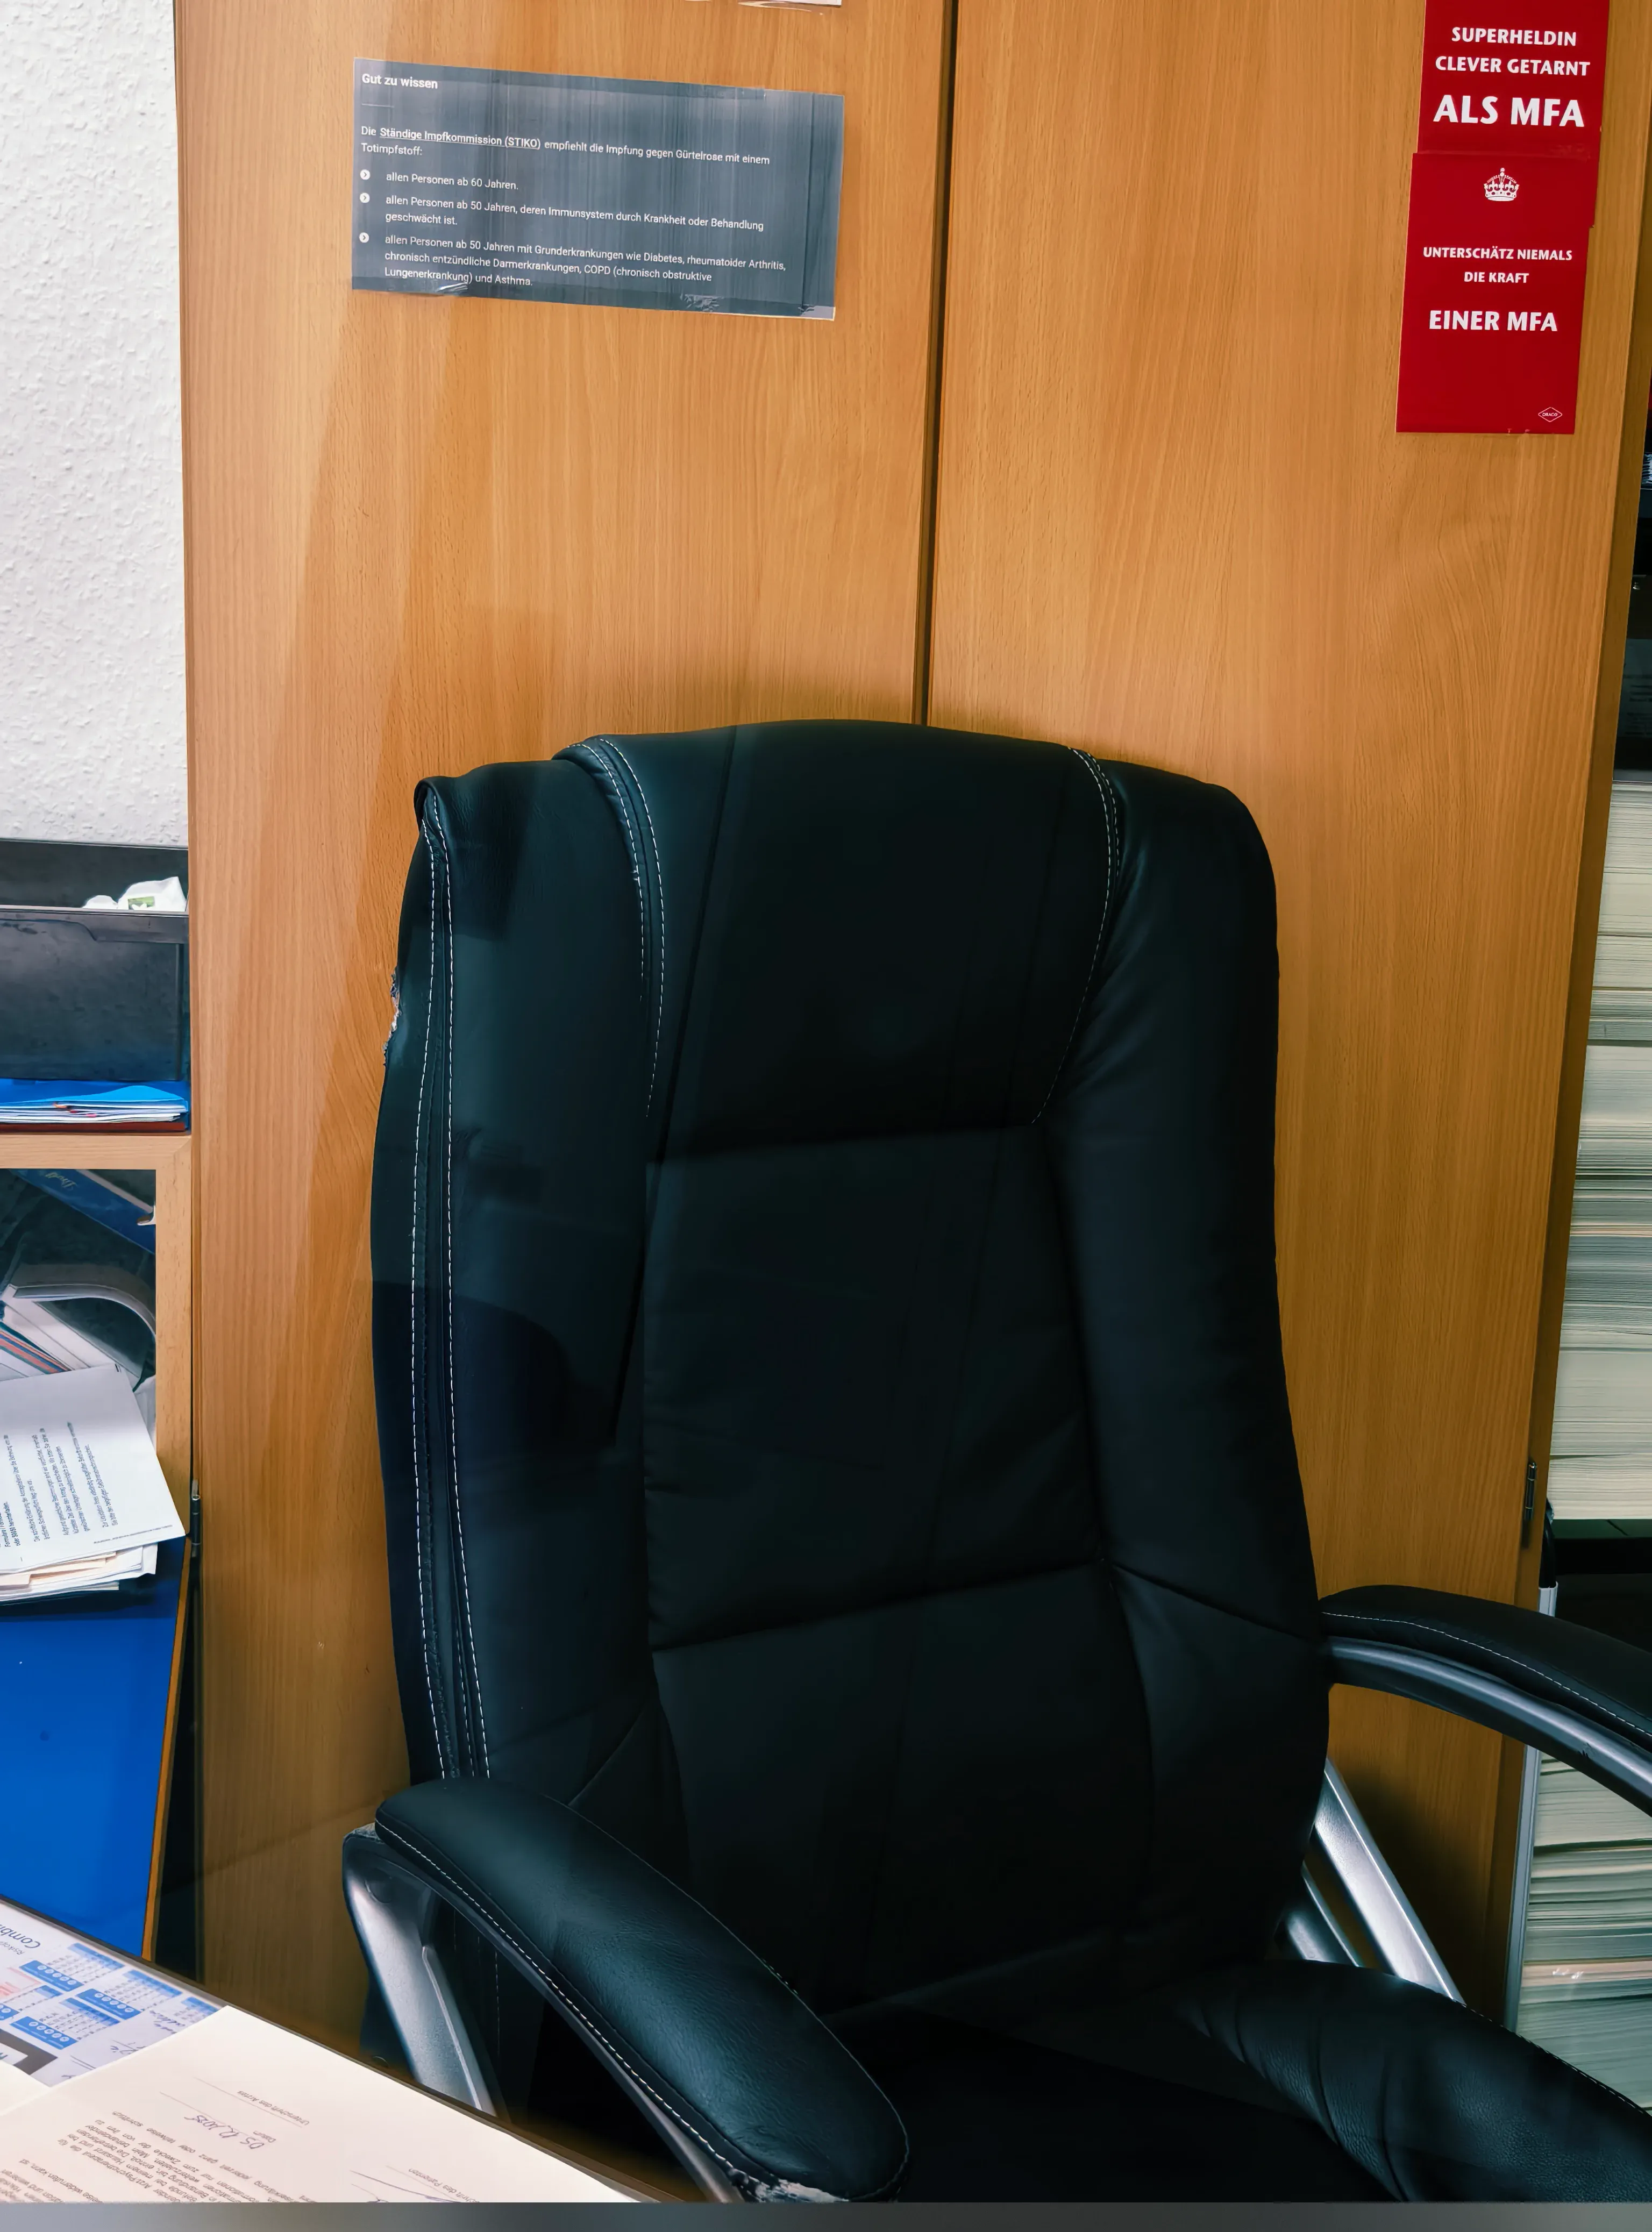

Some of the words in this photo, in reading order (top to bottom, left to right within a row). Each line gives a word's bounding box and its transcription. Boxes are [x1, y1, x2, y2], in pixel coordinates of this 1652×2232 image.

[1451, 26, 1576, 46] SUPERHELDIN
[1435, 55, 1502, 73] CLEVER
[1507, 59, 1591, 76] GETARNT
[362, 73, 381, 84] Gut
[384, 76, 397, 86] zu
[400, 77, 438, 89] wissen
[1433, 95, 1498, 124] ALS
[1511, 97, 1584, 127] MFA
[361, 126, 376, 136] Die
[380, 127, 422, 140] Ständige
[424, 131, 502, 146] Impfkommission
[504, 136, 541, 149] (STIKO)
[544, 141, 587, 153] empfiehlt
[589, 143, 604, 153] die
[606, 145, 644, 158] Impfung
[646, 148, 673, 159] gegen
[675, 149, 723, 161] Gürtelrose
[725, 154, 740, 162] mit
[742, 154, 770, 165] einem
[361, 142, 423, 156] Totimpfstoff:
[386, 173, 409, 182] allen
[411, 174, 454, 185] Personen
[457, 177, 468, 186] ab
[471, 178, 482, 187] 60
[485, 179, 519, 190] Jahren.
[386, 196, 409, 205] allen
[411, 197, 454, 209] Personen
[457, 200, 468, 209] ab
[471, 201, 482, 210] 50
[485, 203, 518, 215] Jahren,
[520, 205, 546, 216] deren
[548, 207, 614, 220] Immunsystem
[616, 212, 642, 222] durch
[644, 213, 686, 225] Krankheit
[688, 216, 709, 226] oder
[711, 218, 764, 232] Behandlung
[386, 213, 442, 225] geschwächt
[443, 216, 458, 225] ist.
[385, 236, 408, 245] allen
[410, 237, 453, 248] Personen
[455, 240, 467, 249] ab
[469, 240, 481, 249] 50
[483, 241, 515, 252] Jahren
[517, 244, 532, 253] mit
[535, 245, 623, 261] Grunderkrankungen
[625, 252, 641, 260] wie
[644, 253, 685, 265] Diabetes,
[687, 256, 746, 268] rheumatoider
[749, 260, 786, 272] Arthritis,
[1423, 246, 1514, 259] UNTERSCHÄTZ
[1517, 249, 1572, 261] NIEMALS
[384, 251, 430, 263] chronisch
[432, 255, 491, 267] entzündliche
[493, 258, 582, 274] Darmerkrankungen,
[584, 265, 611, 275] COPD
[613, 267, 660, 279] (chronisch
[662, 269, 712, 281] obstruktive
[384, 267, 473, 283] Lungenerkrankung)
[475, 274, 493, 283] und
[495, 275, 533, 286] Asthma.
[1464, 272, 1485, 282] DIE
[1489, 272, 1529, 283] KRAFT
[1429, 310, 1500, 331] EINER
[1507, 311, 1557, 332] MFA
